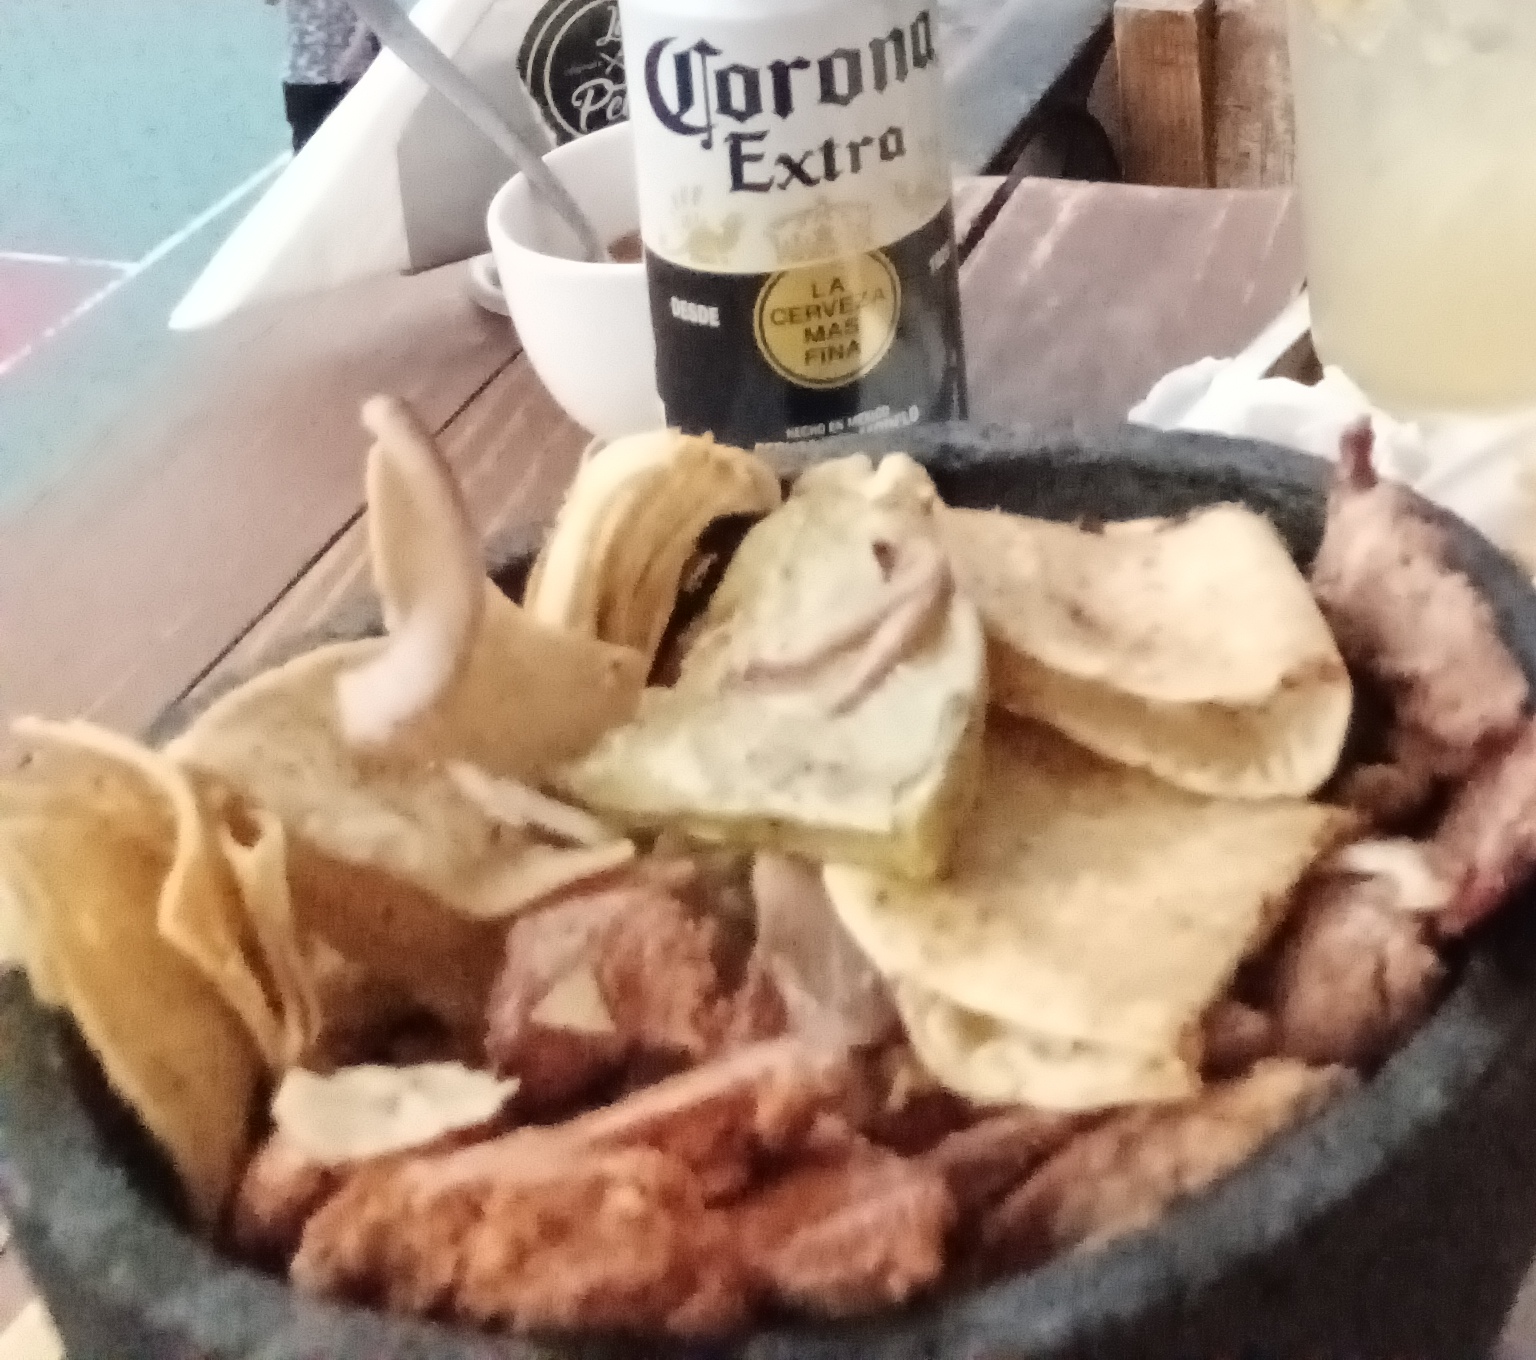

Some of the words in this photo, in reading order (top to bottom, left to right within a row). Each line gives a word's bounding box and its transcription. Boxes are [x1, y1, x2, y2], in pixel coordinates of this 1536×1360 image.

[645, 11, 935, 149] Corona
[725, 127, 906, 192] Extra
[811, 276, 845, 299] LA
[670, 295, 721, 328] DESDE
[804, 317, 861, 343] MAS
[804, 340, 861, 366] FINA
